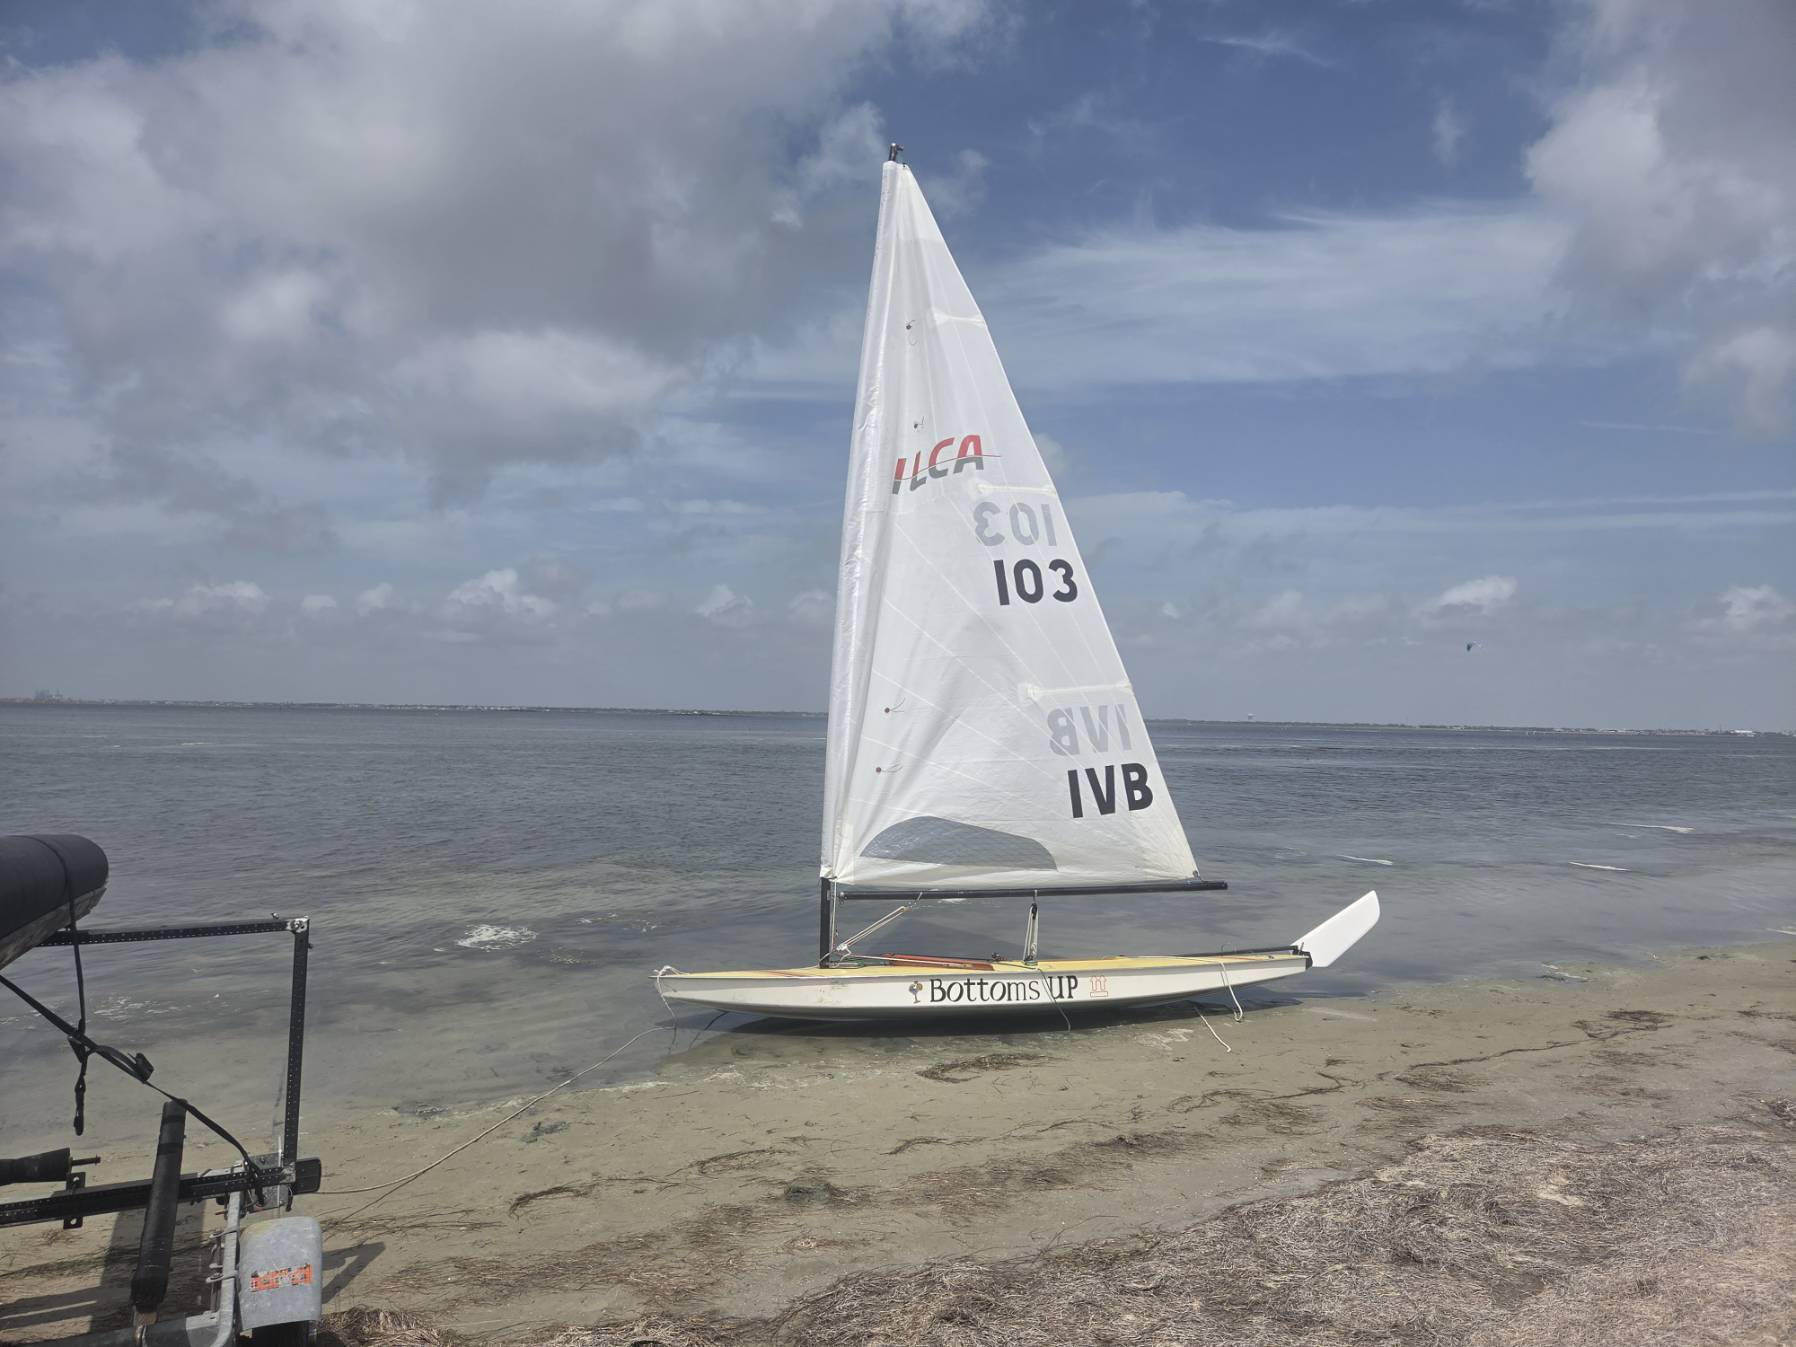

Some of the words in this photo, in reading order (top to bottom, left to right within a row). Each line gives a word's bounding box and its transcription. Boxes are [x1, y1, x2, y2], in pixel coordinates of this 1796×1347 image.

[892, 435, 984, 495] ILCA
[994, 559, 1078, 605] 103
[1068, 763, 1153, 818] IVB
[930, 978, 1040, 1002] Bottoms
[1048, 975, 1078, 999] UP
